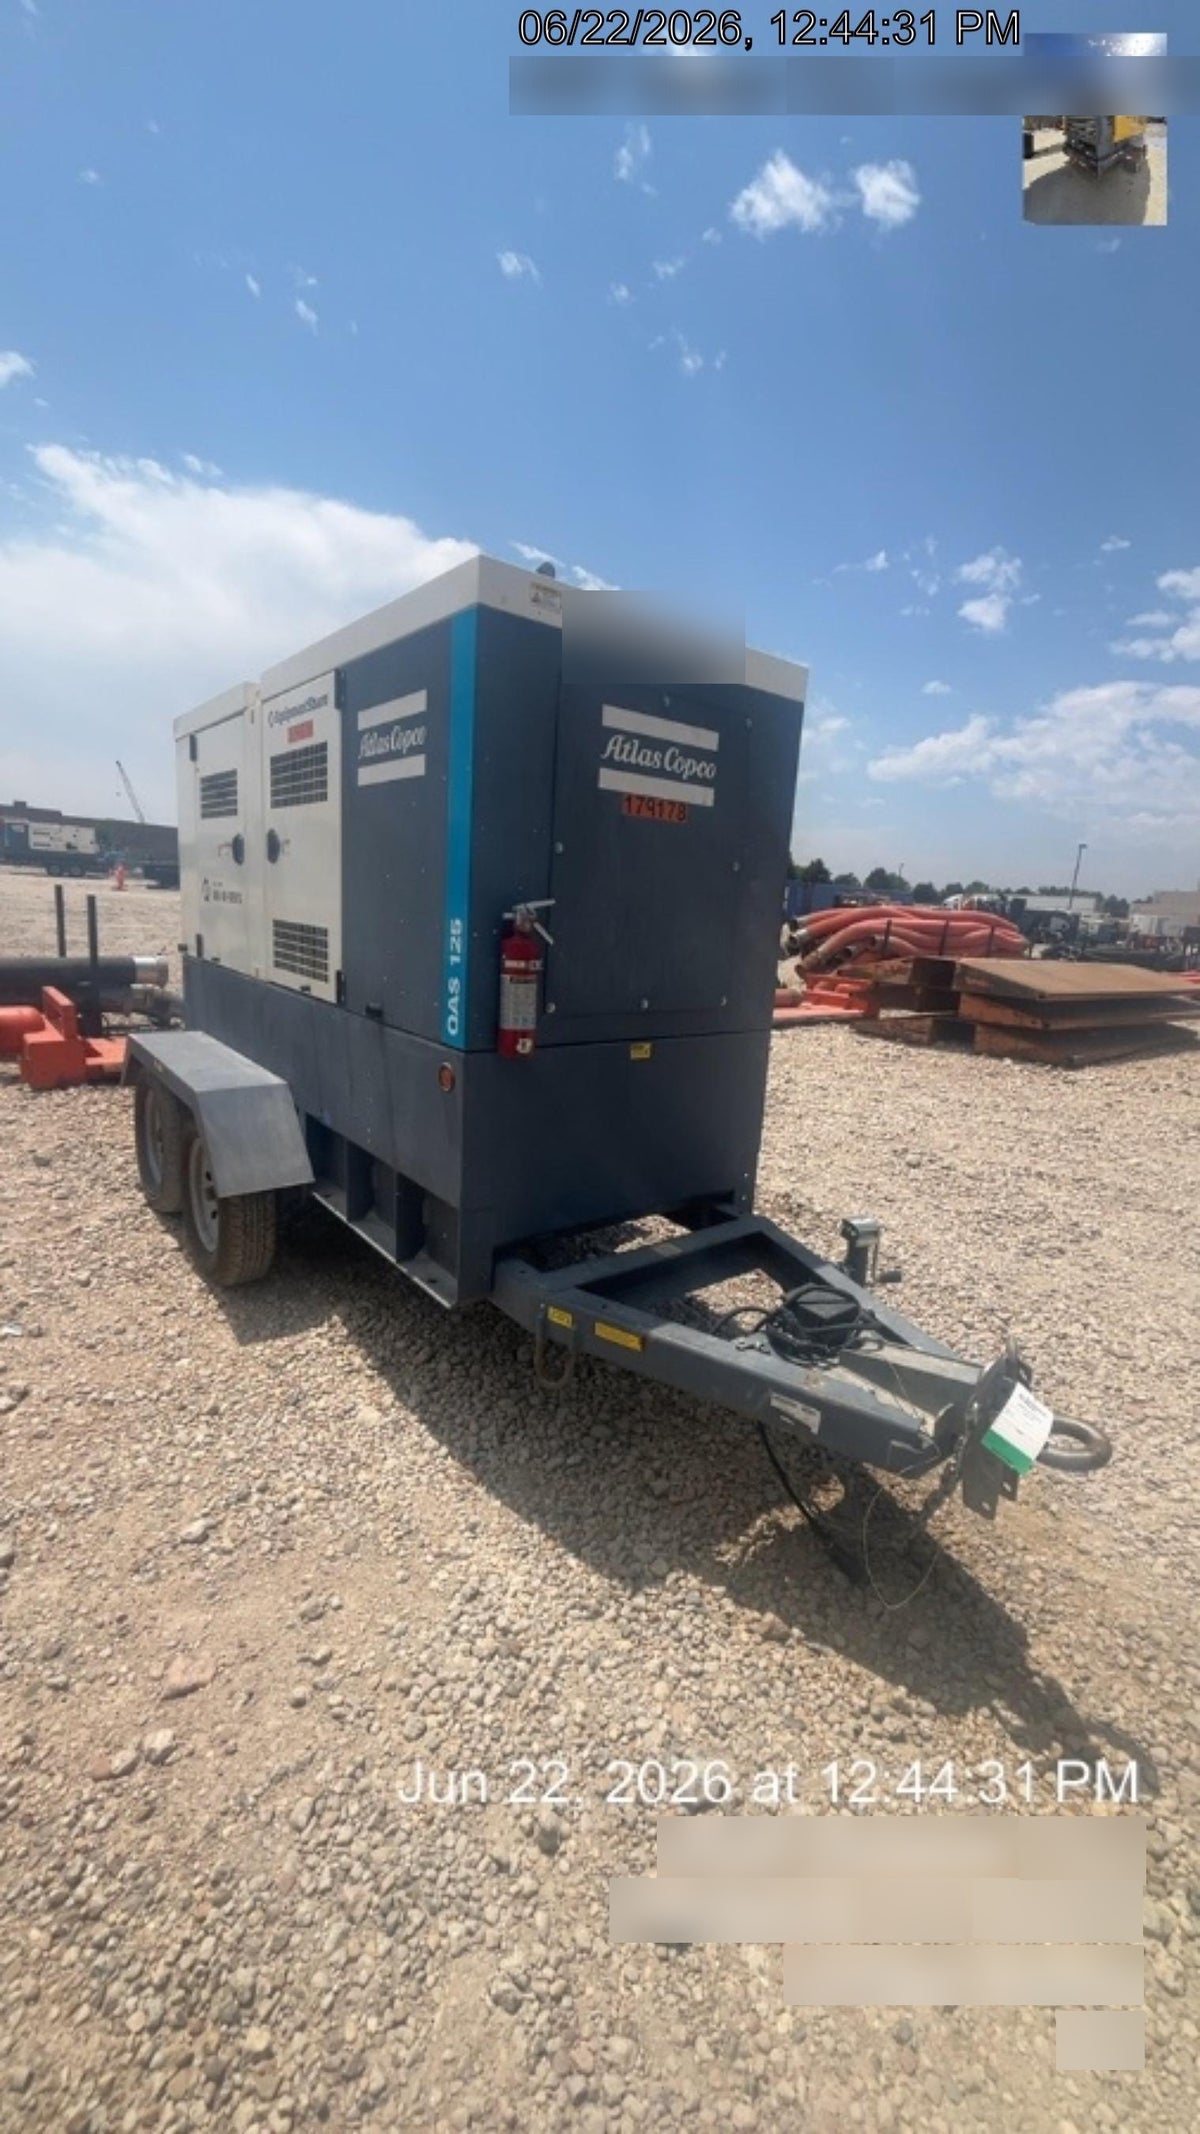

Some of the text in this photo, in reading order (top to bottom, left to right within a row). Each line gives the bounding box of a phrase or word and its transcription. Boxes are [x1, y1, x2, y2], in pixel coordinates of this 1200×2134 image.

[358, 725, 426, 760] Atlas Copco
[601, 734, 717, 781] Atlas Copco
[625, 793, 687, 822] 179178
